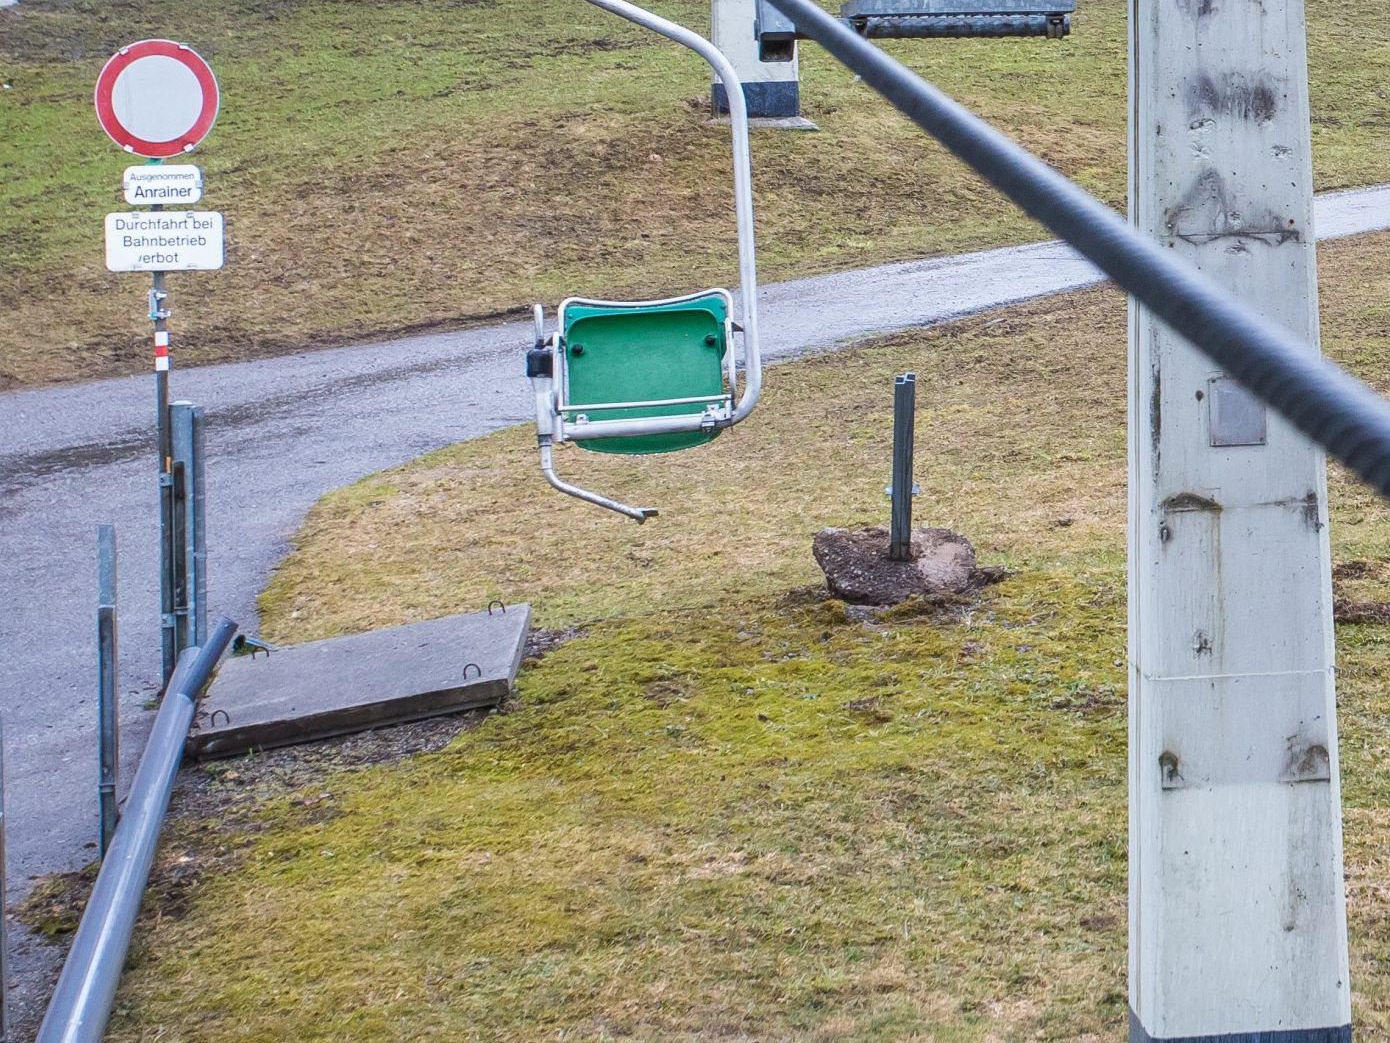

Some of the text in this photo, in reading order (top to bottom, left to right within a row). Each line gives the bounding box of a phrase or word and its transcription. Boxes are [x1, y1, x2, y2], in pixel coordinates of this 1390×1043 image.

[130, 172, 195, 182] Ausgenommen
[134, 185, 193, 198] Anrainer
[115, 217, 213, 231] Durchfahrt bei
[123, 235, 207, 247] Bahnbetrieb
